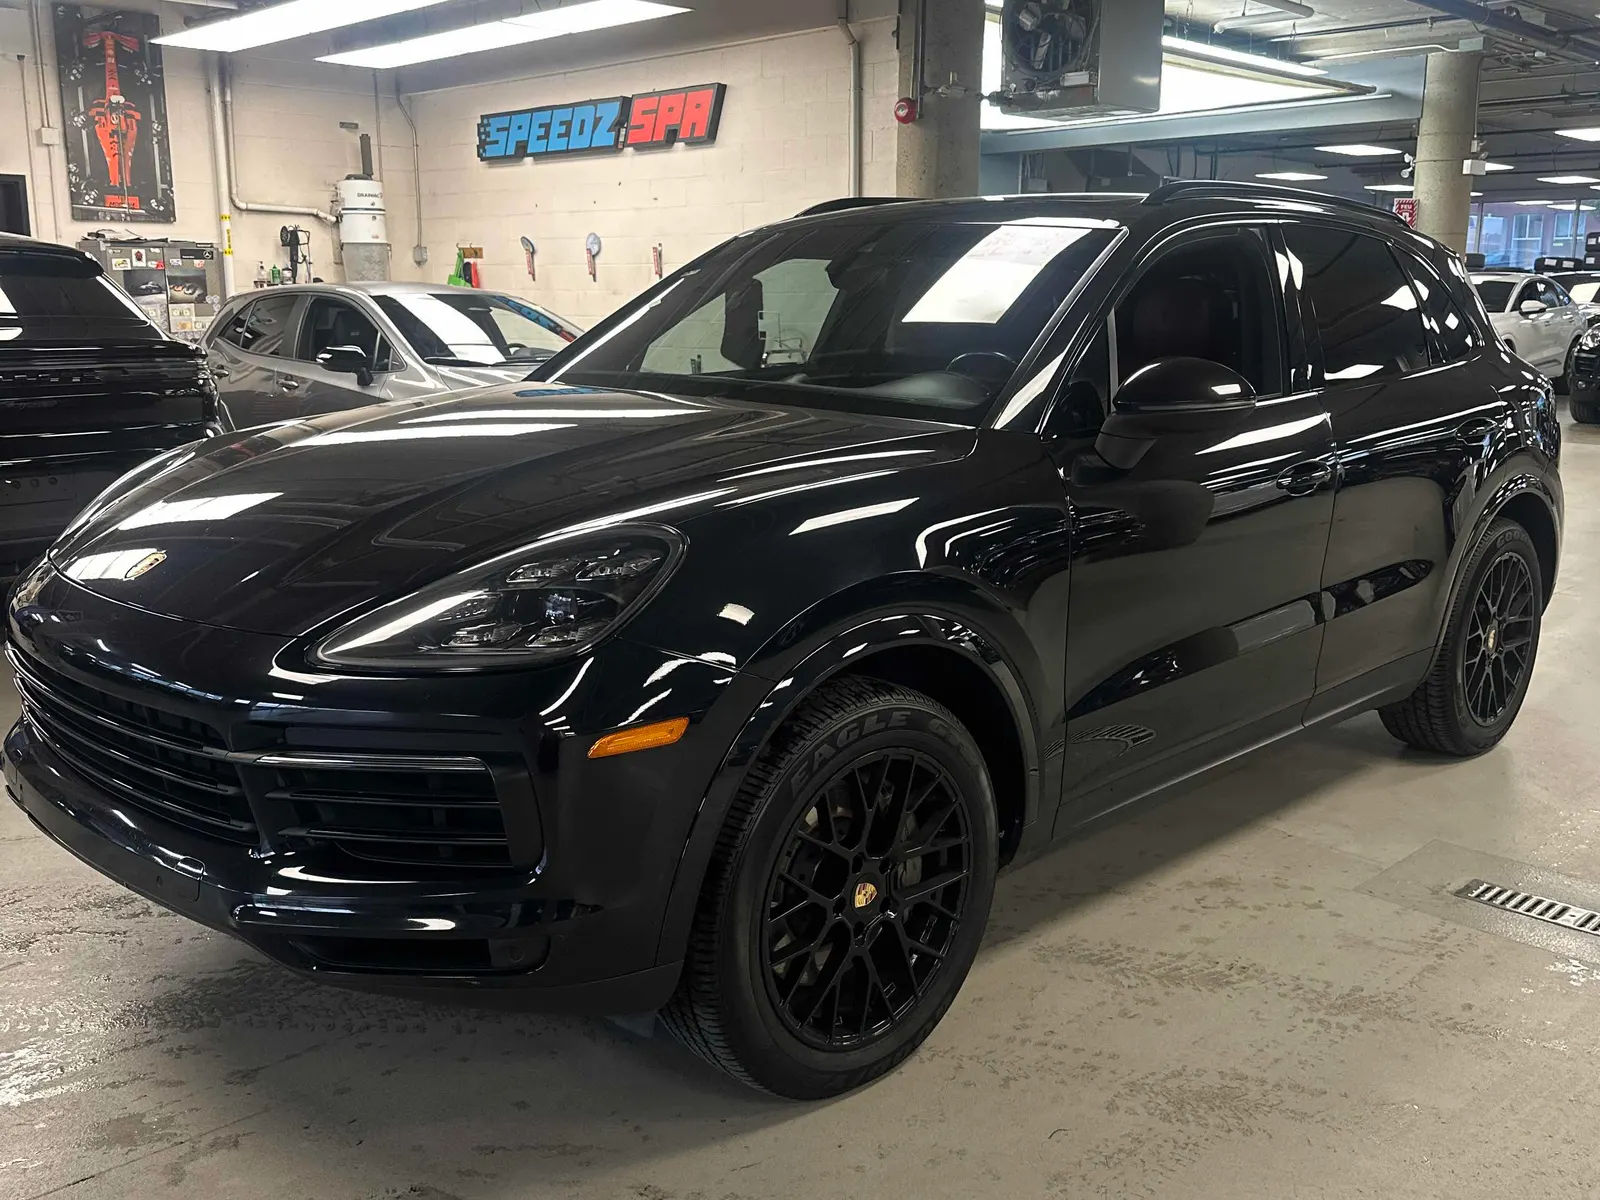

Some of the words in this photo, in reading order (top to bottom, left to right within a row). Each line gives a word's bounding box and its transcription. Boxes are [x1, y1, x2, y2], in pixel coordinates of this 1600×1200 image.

[484, 101, 621, 157] SPEEDZ
[627, 89, 715, 145] SPA
[790, 710, 912, 798] EAGLE
